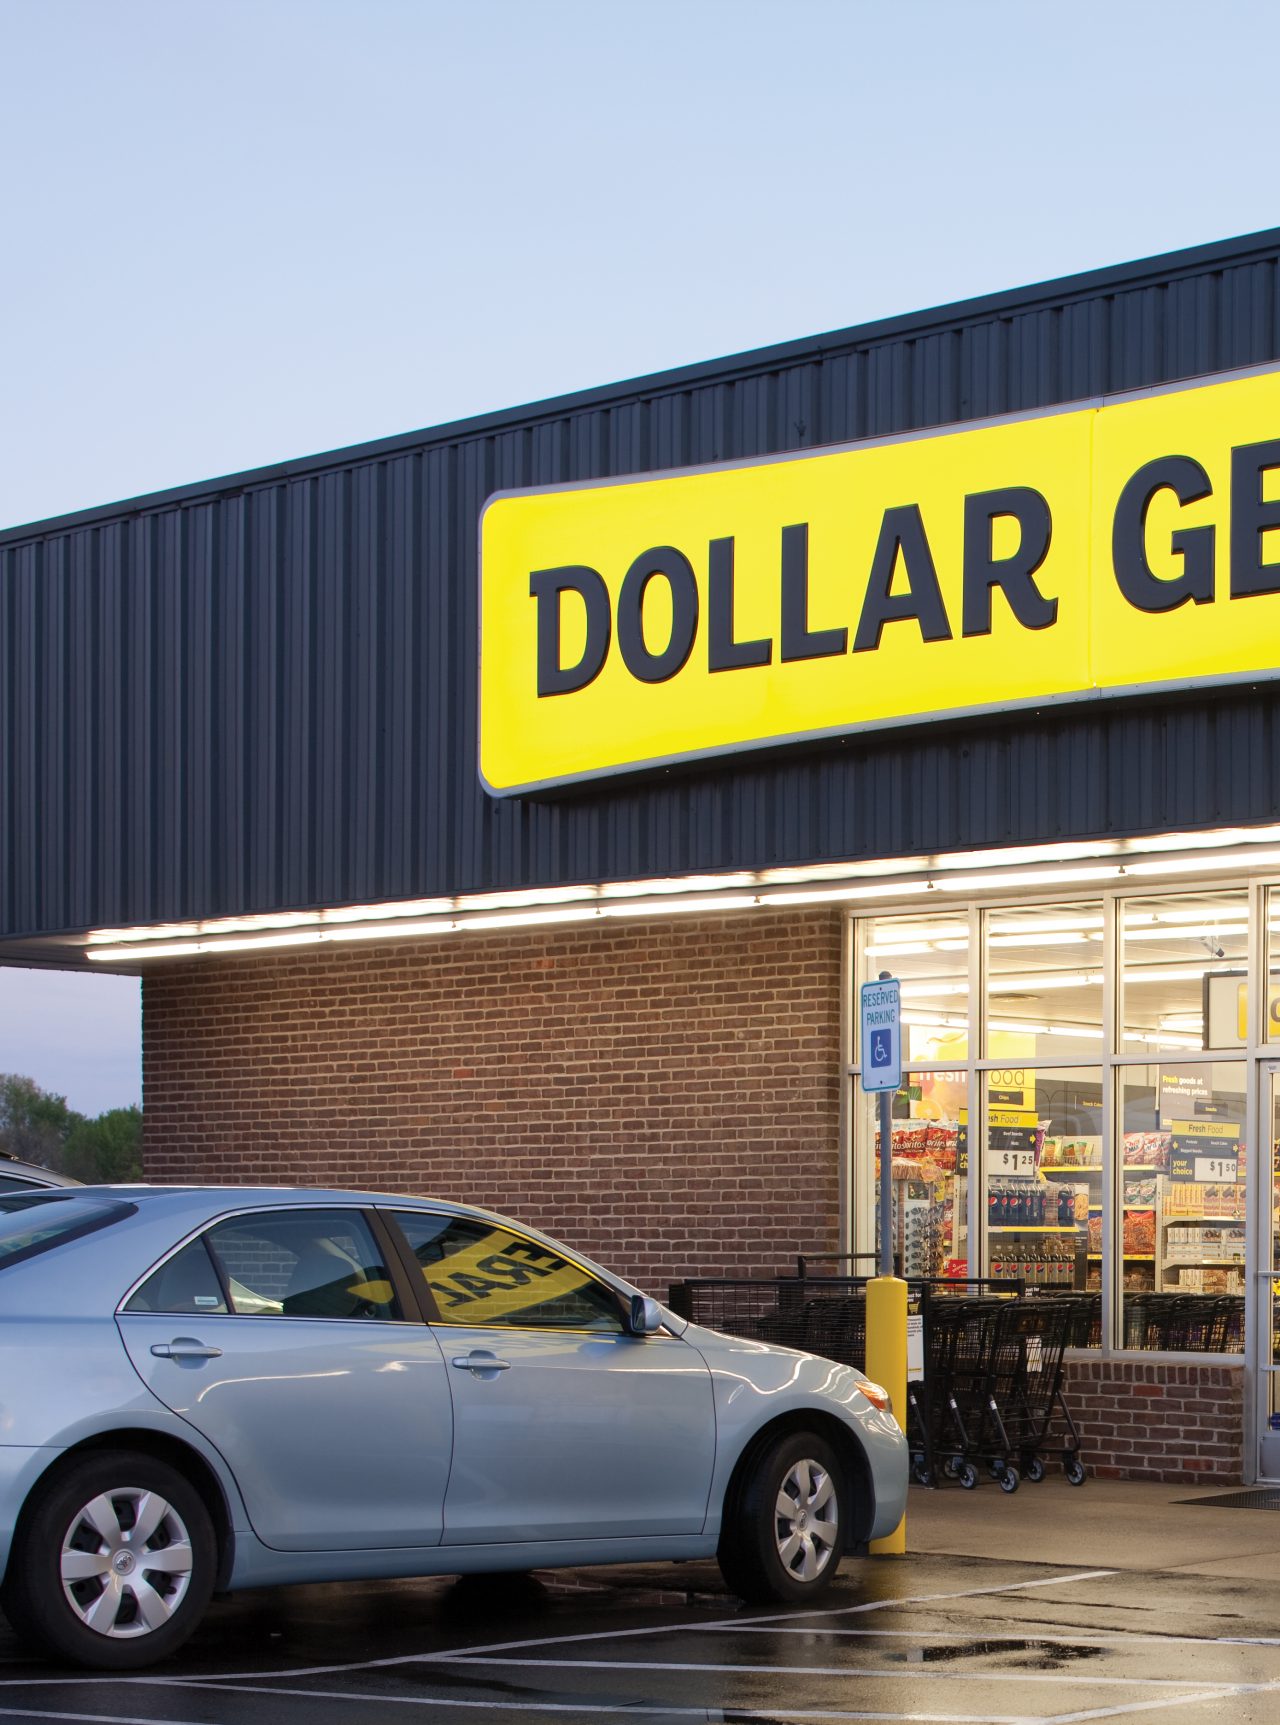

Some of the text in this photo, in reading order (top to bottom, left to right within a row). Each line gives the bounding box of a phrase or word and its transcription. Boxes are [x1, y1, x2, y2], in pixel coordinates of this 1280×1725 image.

[530, 486, 1058, 698] DOLLAR
[863, 989, 898, 1008] RESERVED
[867, 1009, 896, 1025] PARKING
[991, 1069, 1024, 1086] ood
[1188, 1124, 1206, 1132] Fresh
[1173, 1160, 1187, 1168] your
[1173, 1167, 1192, 1175] choice
